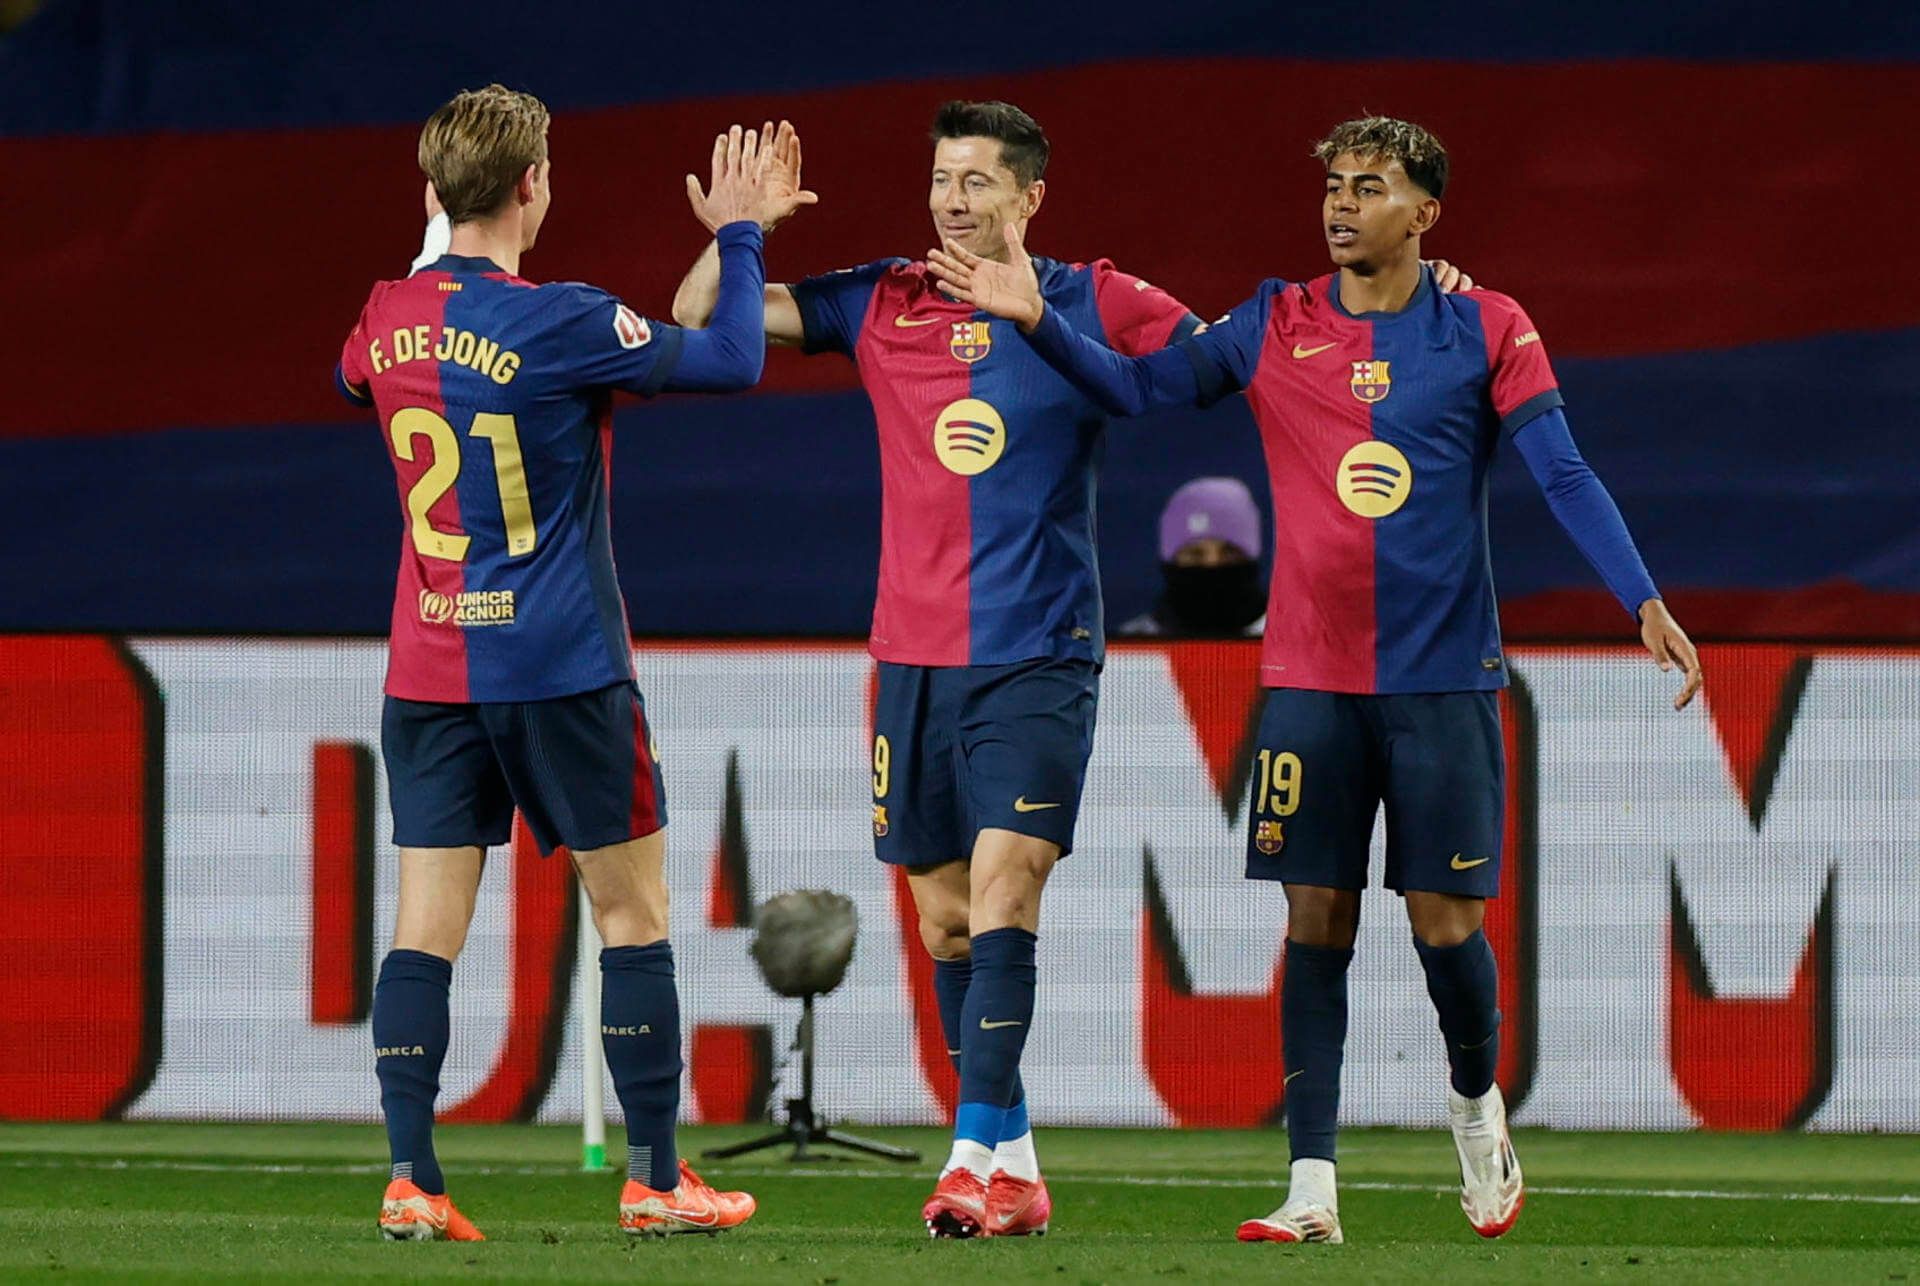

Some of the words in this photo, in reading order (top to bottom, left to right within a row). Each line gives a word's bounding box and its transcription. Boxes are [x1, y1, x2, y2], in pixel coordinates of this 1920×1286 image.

[369, 337, 393, 375] F.
[393, 325, 430, 365] DE
[434, 326, 522, 385] JONG
[389, 407, 536, 562] 21
[453, 604, 514, 620] ACNUR
[455, 590, 514, 607] UNHCR
[873, 734, 890, 798] 9
[1256, 748, 1302, 817] 19
